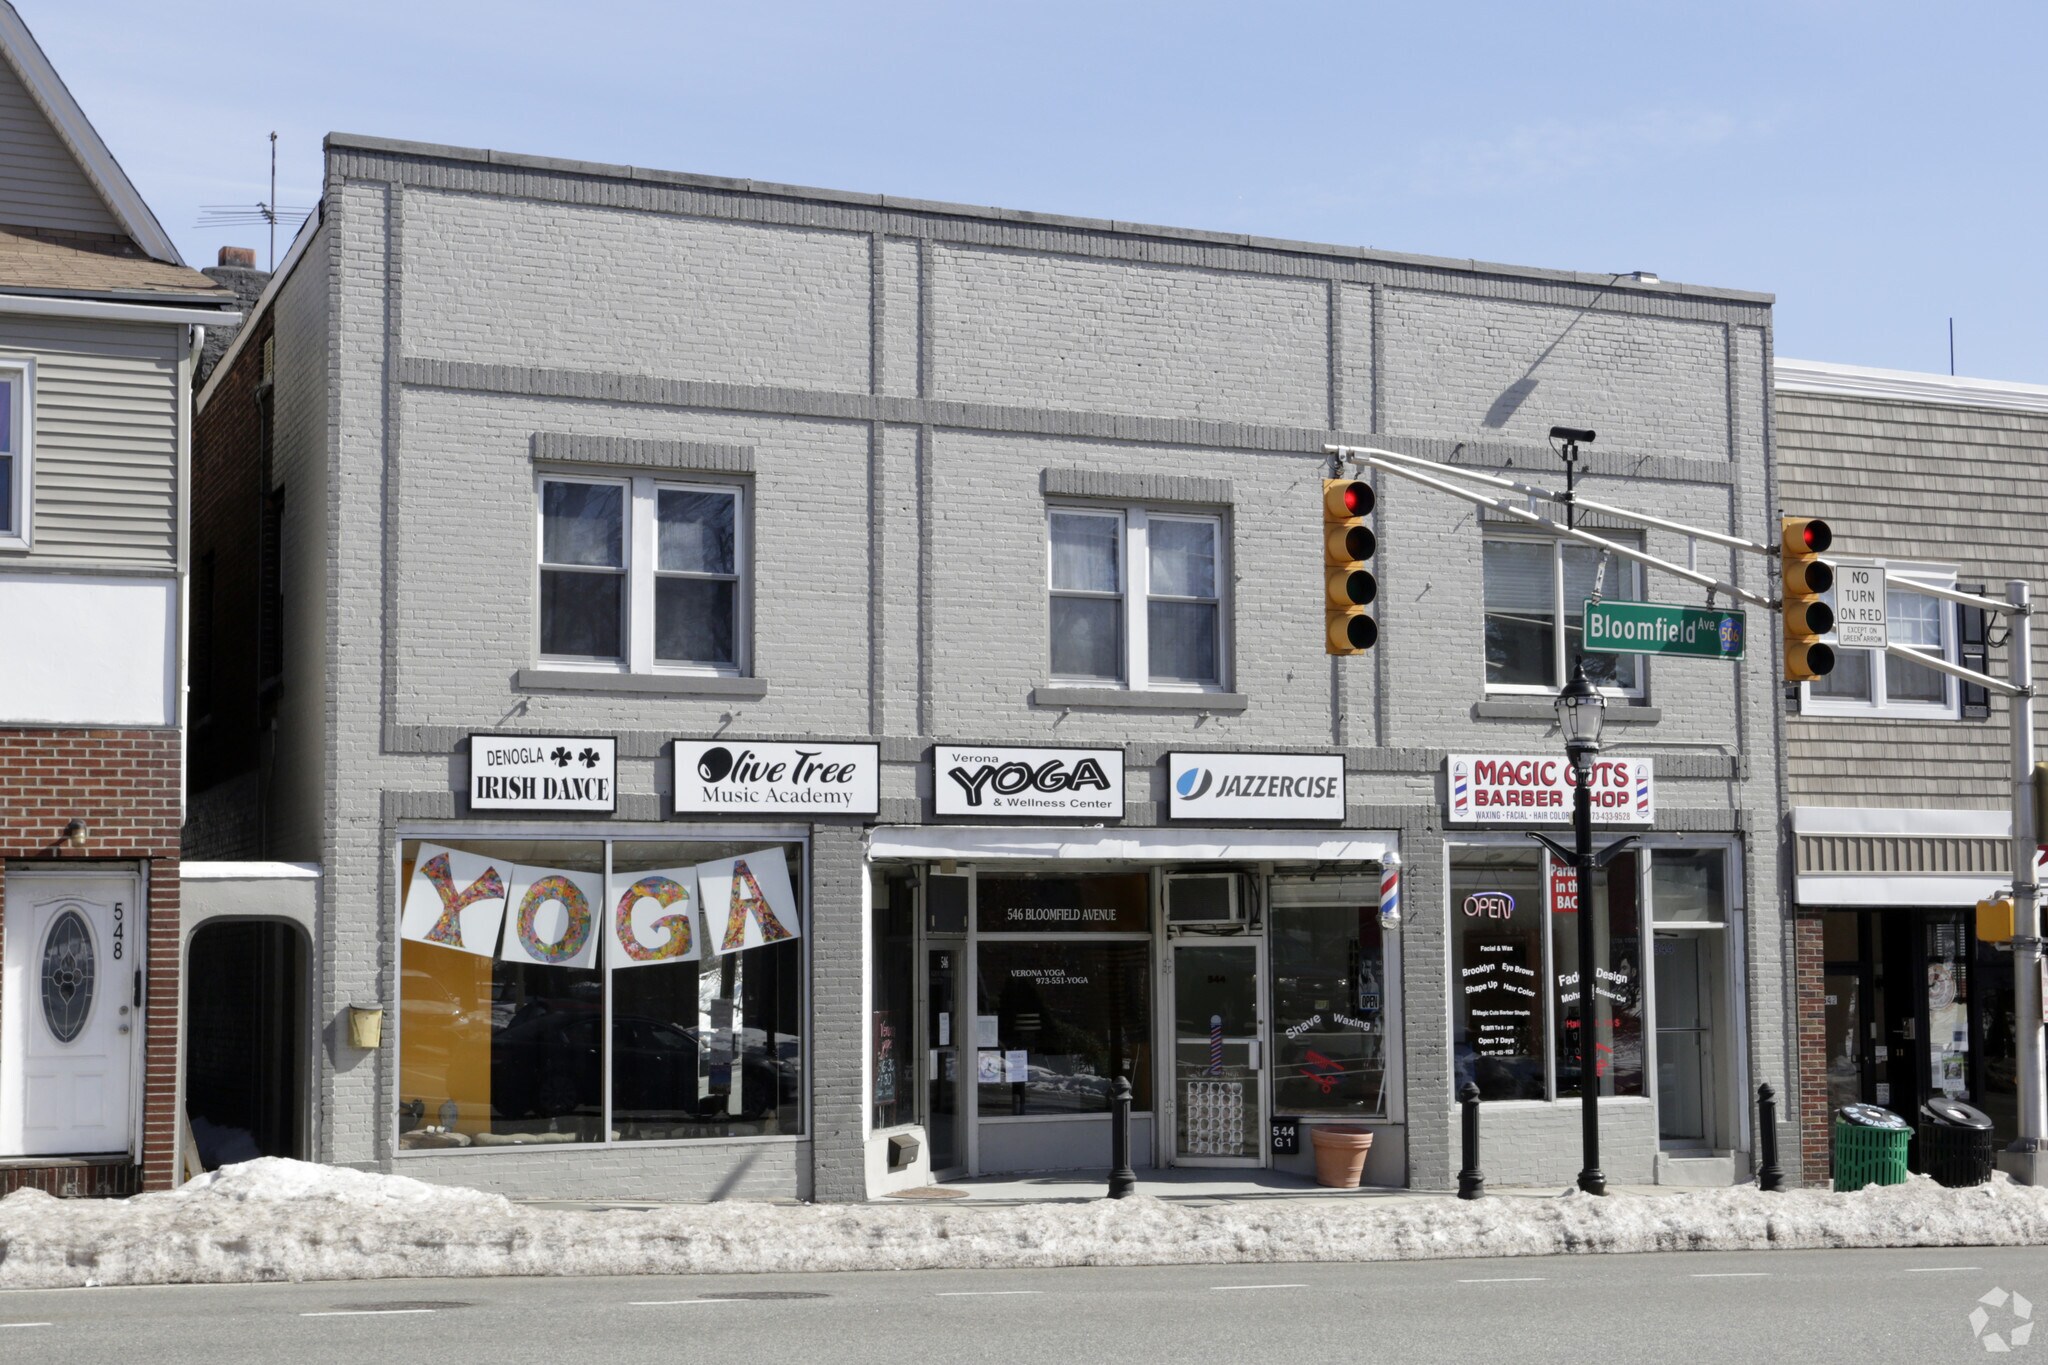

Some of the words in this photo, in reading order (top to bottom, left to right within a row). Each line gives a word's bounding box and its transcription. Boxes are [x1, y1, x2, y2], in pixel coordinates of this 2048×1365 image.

[1852, 571, 1868, 584] NO
[1846, 590, 1875, 602] TURN
[1840, 608, 1856, 620] ON
[1860, 609, 1882, 621] RED
[1590, 613, 1696, 644] Bloomfield
[1698, 617, 1717, 632] Ave.
[1721, 627, 1739, 642] 506
[1847, 626, 1867, 634] EXCEPT
[487, 746, 544, 766] DENOGLA
[952, 753, 999, 764] Verona
[697, 746, 786, 784] Olive
[792, 749, 857, 784] Tree
[1474, 760, 1556, 786] MAGIC
[476, 775, 534, 800] IRISH
[543, 776, 609, 802] DANCE
[948, 758, 1111, 806] YOGA
[1216, 775, 1338, 799] JAZZERCISE
[702, 786, 760, 804] Music
[764, 786, 853, 809] Academy
[994, 798, 1002, 807] &
[1007, 797, 1066, 808] Wellness
[1070, 799, 1112, 809] Center
[1474, 790, 1563, 808] BARBER
[1576, 791, 1630, 808] HOP
[1476, 811, 1502, 820] WAXING
[1506, 811, 1528, 820] FACIAL
[1533, 811, 1548, 820] HAIR
[1550, 812, 1569, 820] COLOR
[1591, 812, 1631, 821] 73-433-9528
[1550, 864, 1576, 877] Parki
[1556, 879, 1566, 893] in
[1568, 880, 1578, 893] th
[420, 852, 793, 963] YOGA
[1463, 896, 1511, 920] OPEN
[1557, 896, 1578, 909] BAC
[1007, 908, 1024, 921] 546
[1025, 908, 1080, 921] BLOOMFIELD
[1082, 908, 1117, 921] AVENUE
[1011, 970, 1042, 978] VERONA
[1462, 963, 1496, 977] Brooklyn
[1502, 962, 1514, 972] Eye
[1514, 966, 1534, 976] Brows
[1036, 976, 1088, 985] 973-551-YOGA
[1208, 976, 1226, 984] 544
[1558, 972, 1580, 986] Fad
[1596, 968, 1628, 984] Design
[1465, 983, 1487, 994] Shape
[1488, 980, 1498, 990] Up
[1503, 982, 1516, 991] Hair
[1518, 986, 1536, 998] Color
[1561, 991, 1580, 1004] Moha
[1596, 986, 1616, 1000] Scissor
[1616, 994, 1626, 1002] Cut
[1362, 995, 1378, 1008] OPEN
[1285, 1012, 1322, 1040] Shave
[1333, 1012, 1370, 1032] Waxing
[1566, 1018, 1580, 1028] Hai
[1500, 1037, 1514, 1045] Days
[1272, 1126, 1294, 1137] 544
[1274, 1138, 1284, 1148] G
[1286, 1138, 1292, 1148] 1
